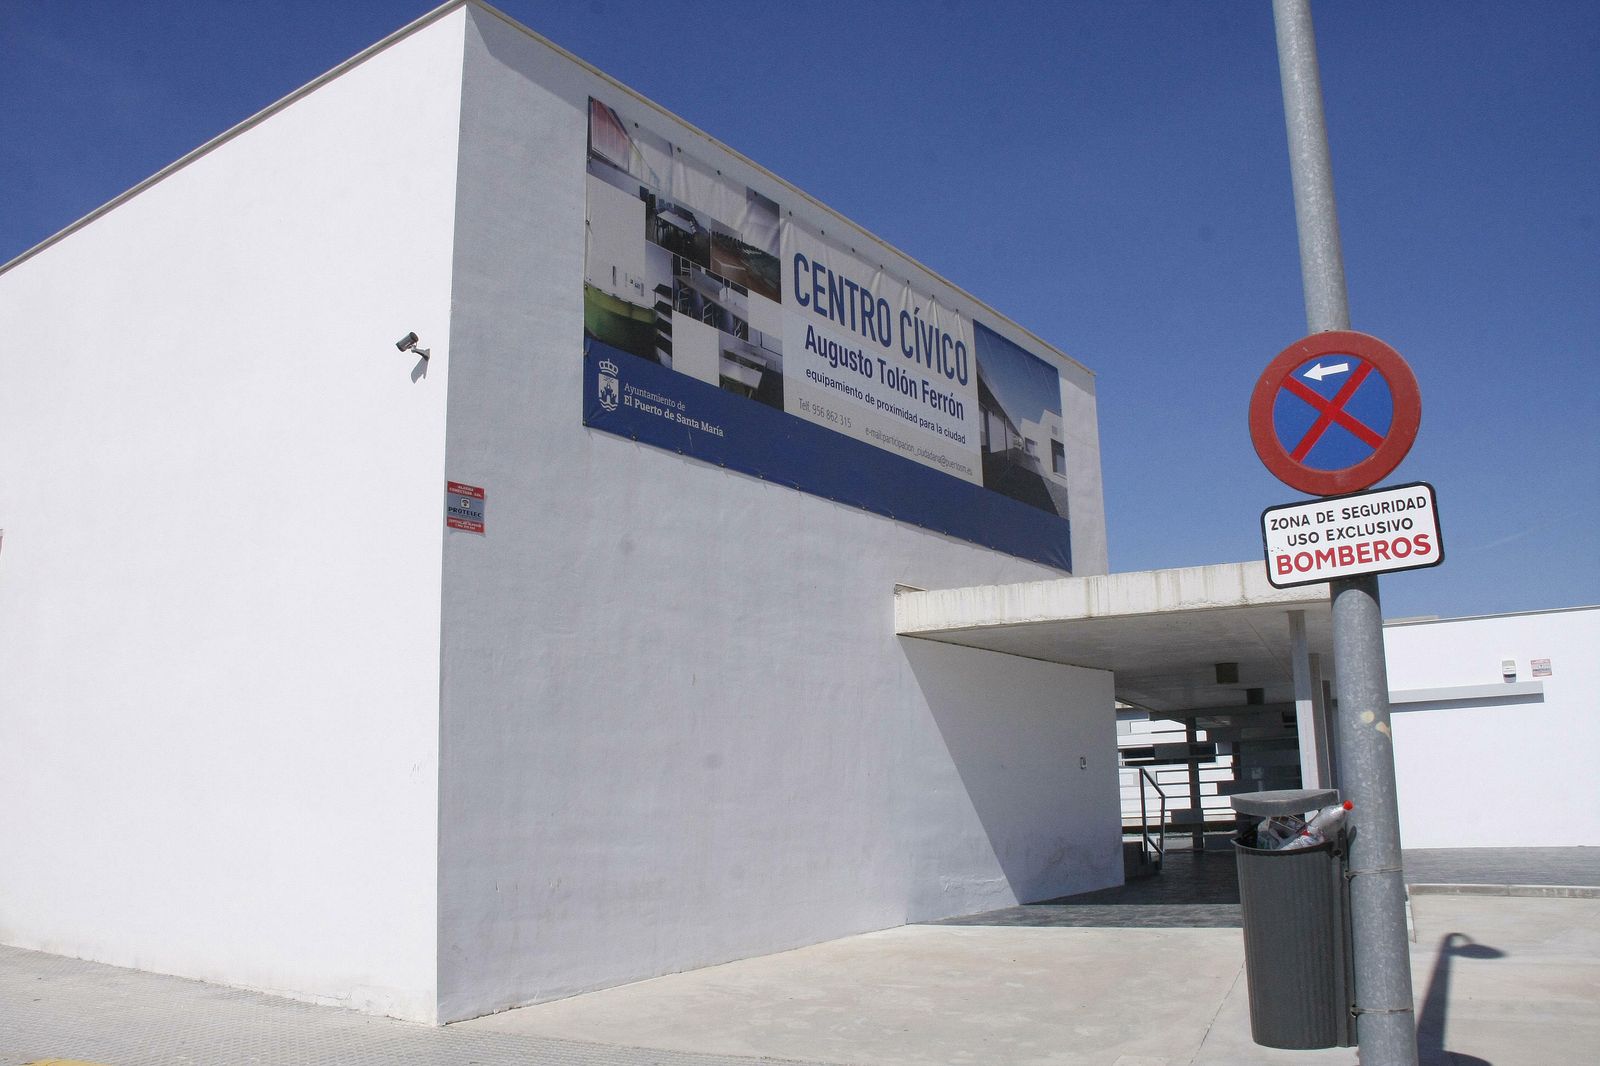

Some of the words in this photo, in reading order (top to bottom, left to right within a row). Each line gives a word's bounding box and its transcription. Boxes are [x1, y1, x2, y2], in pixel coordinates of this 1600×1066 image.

[793, 252, 892, 348] CENTRO
[899, 306, 968, 386] CÍVICO
[805, 324, 873, 379] Augusto
[877, 357, 918, 399] Tolón
[921, 379, 964, 421] Ferrón
[624, 382, 676, 409] Ayuntamiento
[676, 400, 686, 412] de
[624, 395, 633, 406] El
[634, 398, 663, 417] Puerto
[664, 409, 675, 421] de
[676, 412, 700, 430] Santa
[700, 420, 724, 438] María
[805, 368, 863, 400] equipamiento
[864, 392, 876, 405] de
[876, 398, 918, 424] proximidad
[919, 417, 935, 431] para
[935, 423, 943, 434] la
[943, 425, 966, 445] ciudad
[812, 404, 825, 419] 956
[826, 411, 839, 425] 862
[840, 413, 852, 429] 315
[1270, 514, 1311, 531] ZONA
[1316, 510, 1335, 524] DE
[1341, 496, 1427, 520] SEGURIDAD
[1287, 531, 1320, 547] USO
[1326, 517, 1414, 541] EXCLUSIVO
[1276, 533, 1432, 576] BOMBEROS
